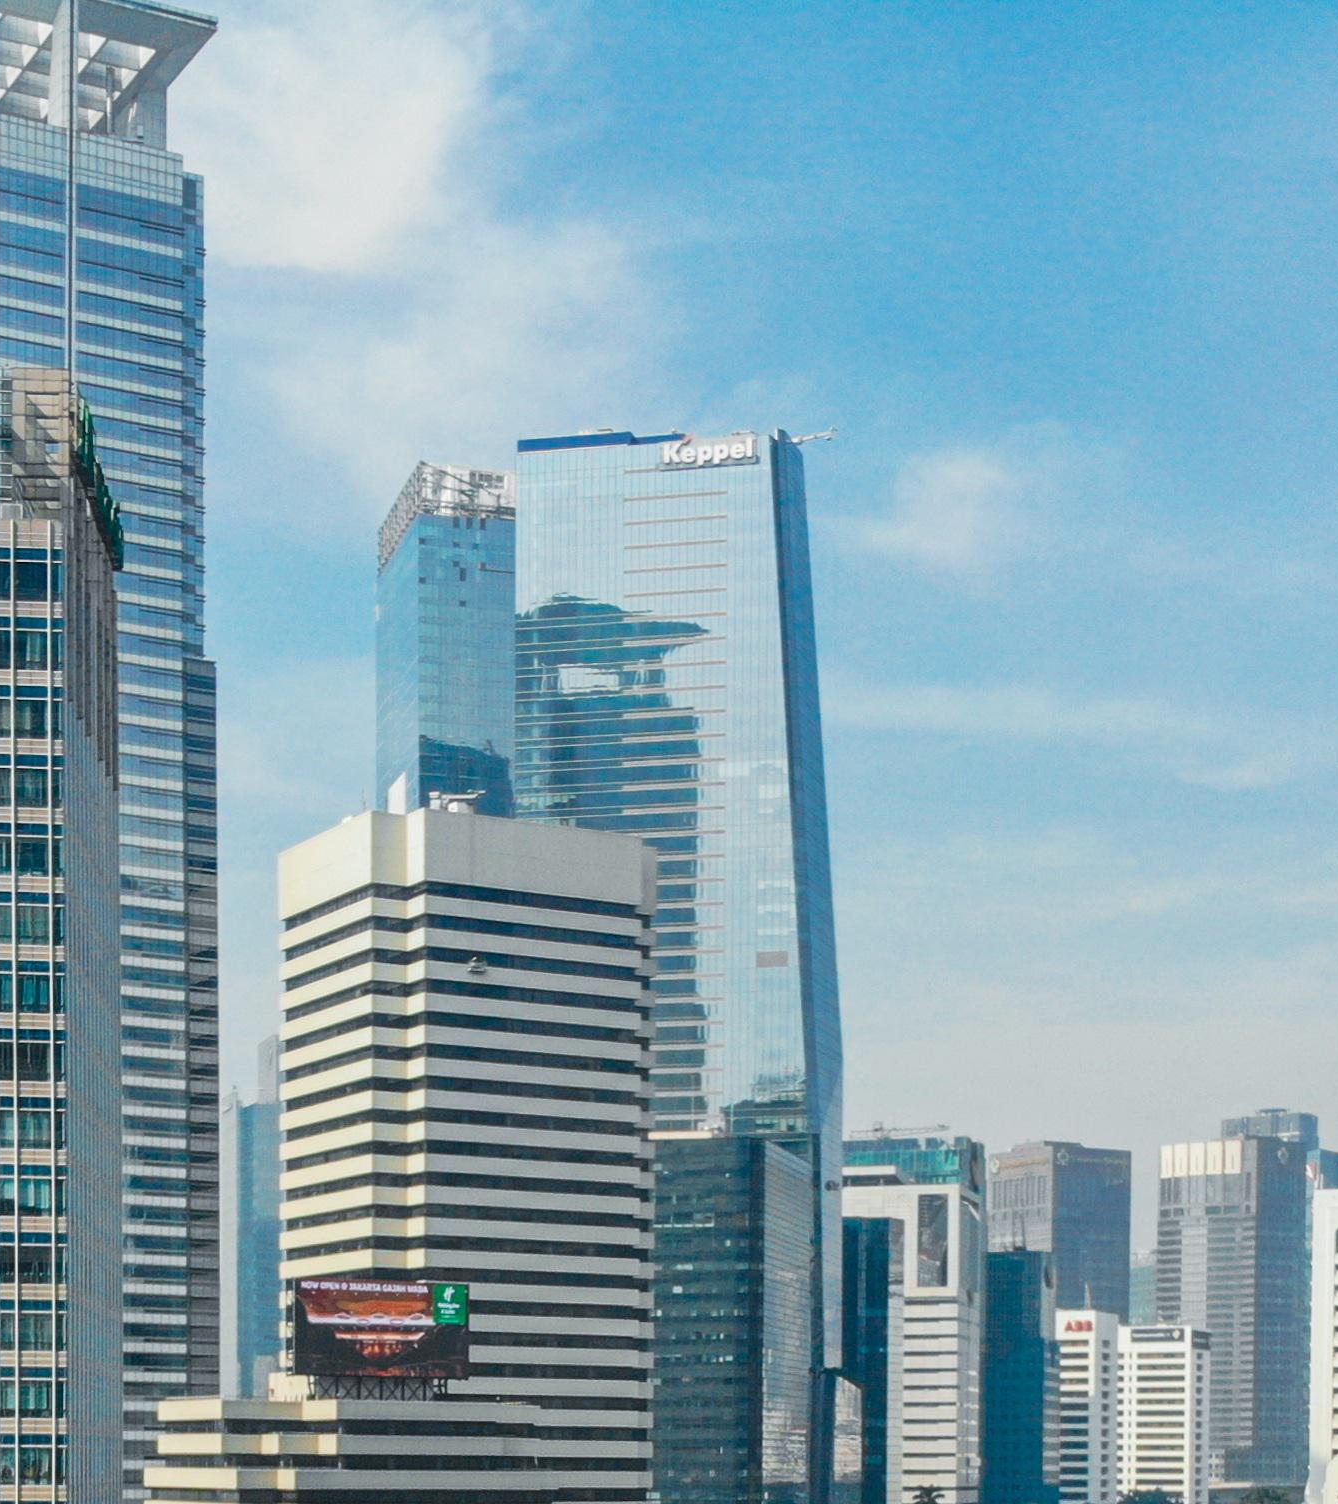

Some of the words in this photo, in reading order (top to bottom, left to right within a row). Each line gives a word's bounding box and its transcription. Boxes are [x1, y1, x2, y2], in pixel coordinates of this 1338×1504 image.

[663, 438, 753, 466] Keppel
[301, 1281, 319, 1289] NOW
[320, 1282, 339, 1290] OPEN
[349, 1283, 381, 1291] JAKARTA
[1064, 1320, 1093, 1332] ABB
